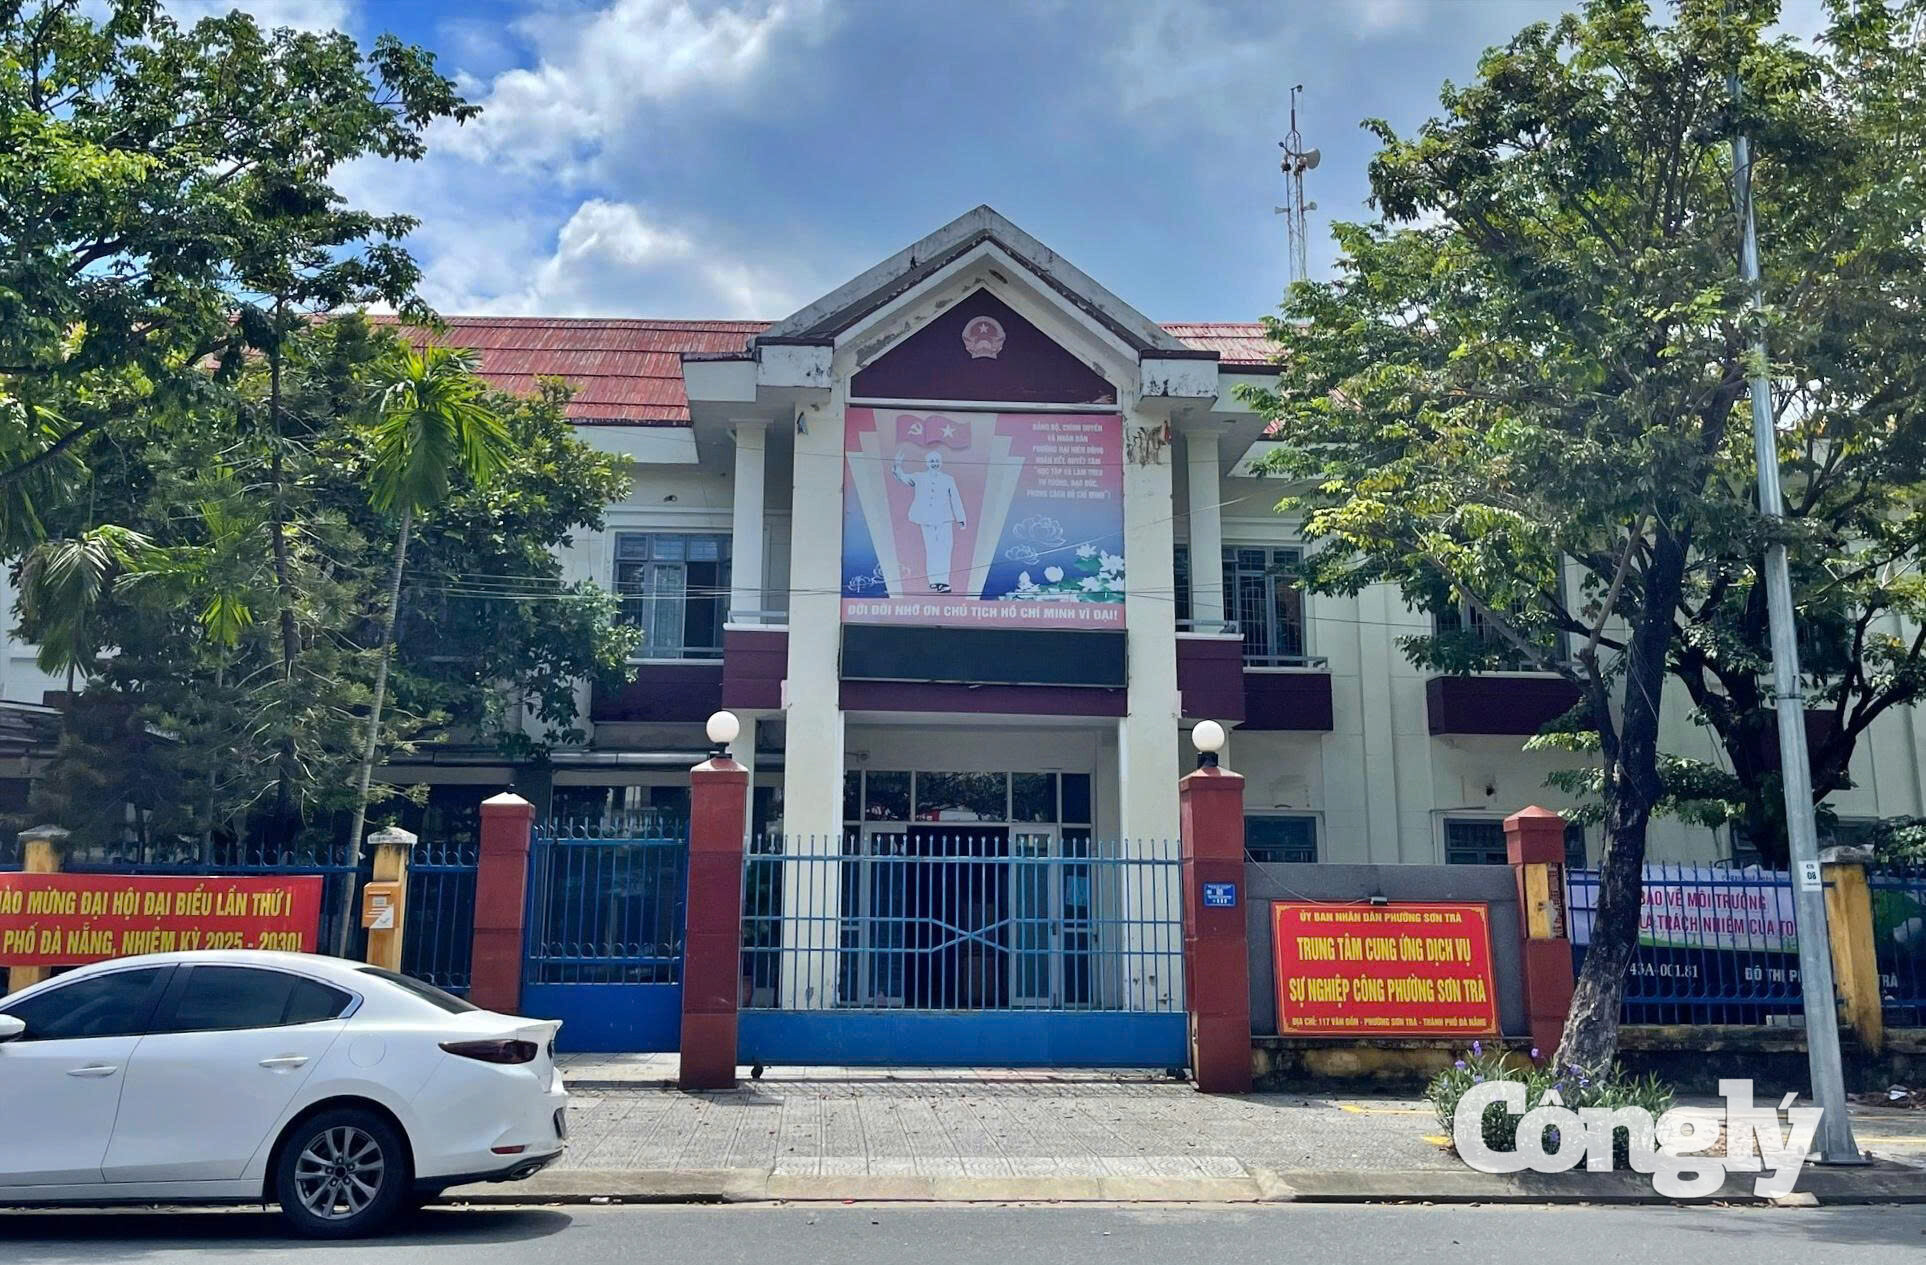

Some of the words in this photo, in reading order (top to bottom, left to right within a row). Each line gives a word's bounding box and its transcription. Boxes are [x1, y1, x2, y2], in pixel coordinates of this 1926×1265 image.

[848, 603, 868, 616] ĐỜI
[871, 603, 892, 616] ĐỜI
[895, 604, 920, 616] NHỚ
[923, 604, 940, 617] ƠN
[943, 603, 968, 618] CHỦ
[971, 606, 997, 621] TỊCH
[1000, 605, 1017, 619] HỒ
[1020, 606, 1040, 619] CHÍ
[1043, 608, 1075, 620] MINH
[0, 884, 24, 915] ÀO
[26, 885, 77, 915] MỪNG
[80, 891, 109, 921] ĐẠI
[112, 886, 141, 921] HỘI
[144, 891, 172, 921] ĐẠI
[175, 882, 213, 917] BIỂU
[215, 884, 248, 917] LẦN
[252, 887, 284, 917] THỨ
[1299, 909, 1312, 923] ỦY
[1314, 911, 1334, 923] BAN
[1335, 910, 1361, 923] NHÂN
[1362, 911, 1382, 923] DÂN
[1384, 910, 1421, 924] PHƯỜNG
[1423, 911, 1442, 924] SƠN
[1444, 911, 1462, 924] TRÀ
[2, 921, 39, 955] PHỐ
[40, 925, 62, 955] ĐÀ
[66, 922, 117, 958] NẴNG,
[121, 926, 176, 955] NHIỆM
[179, 926, 202, 951] KỲ
[204, 931, 244, 951] 2025
[258, 931, 303, 953] 2030!
[1296, 936, 1335, 962] TRUNG
[1337, 932, 1363, 961] TÂM
[1365, 937, 1398, 962] CUNG
[1400, 932, 1424, 962] ỨNG
[1427, 937, 1453, 967] DỊCH
[1455, 938, 1472, 967] VỤ
[1289, 975, 1306, 1008] SỰ
[1307, 973, 1350, 1008] NGHIỆP
[1353, 974, 1385, 1002] CÔNG
[1387, 973, 1435, 1003] PHƯỜNG
[1437, 976, 1462, 1003] SƠN
[1463, 974, 1487, 1003] TRÀ
